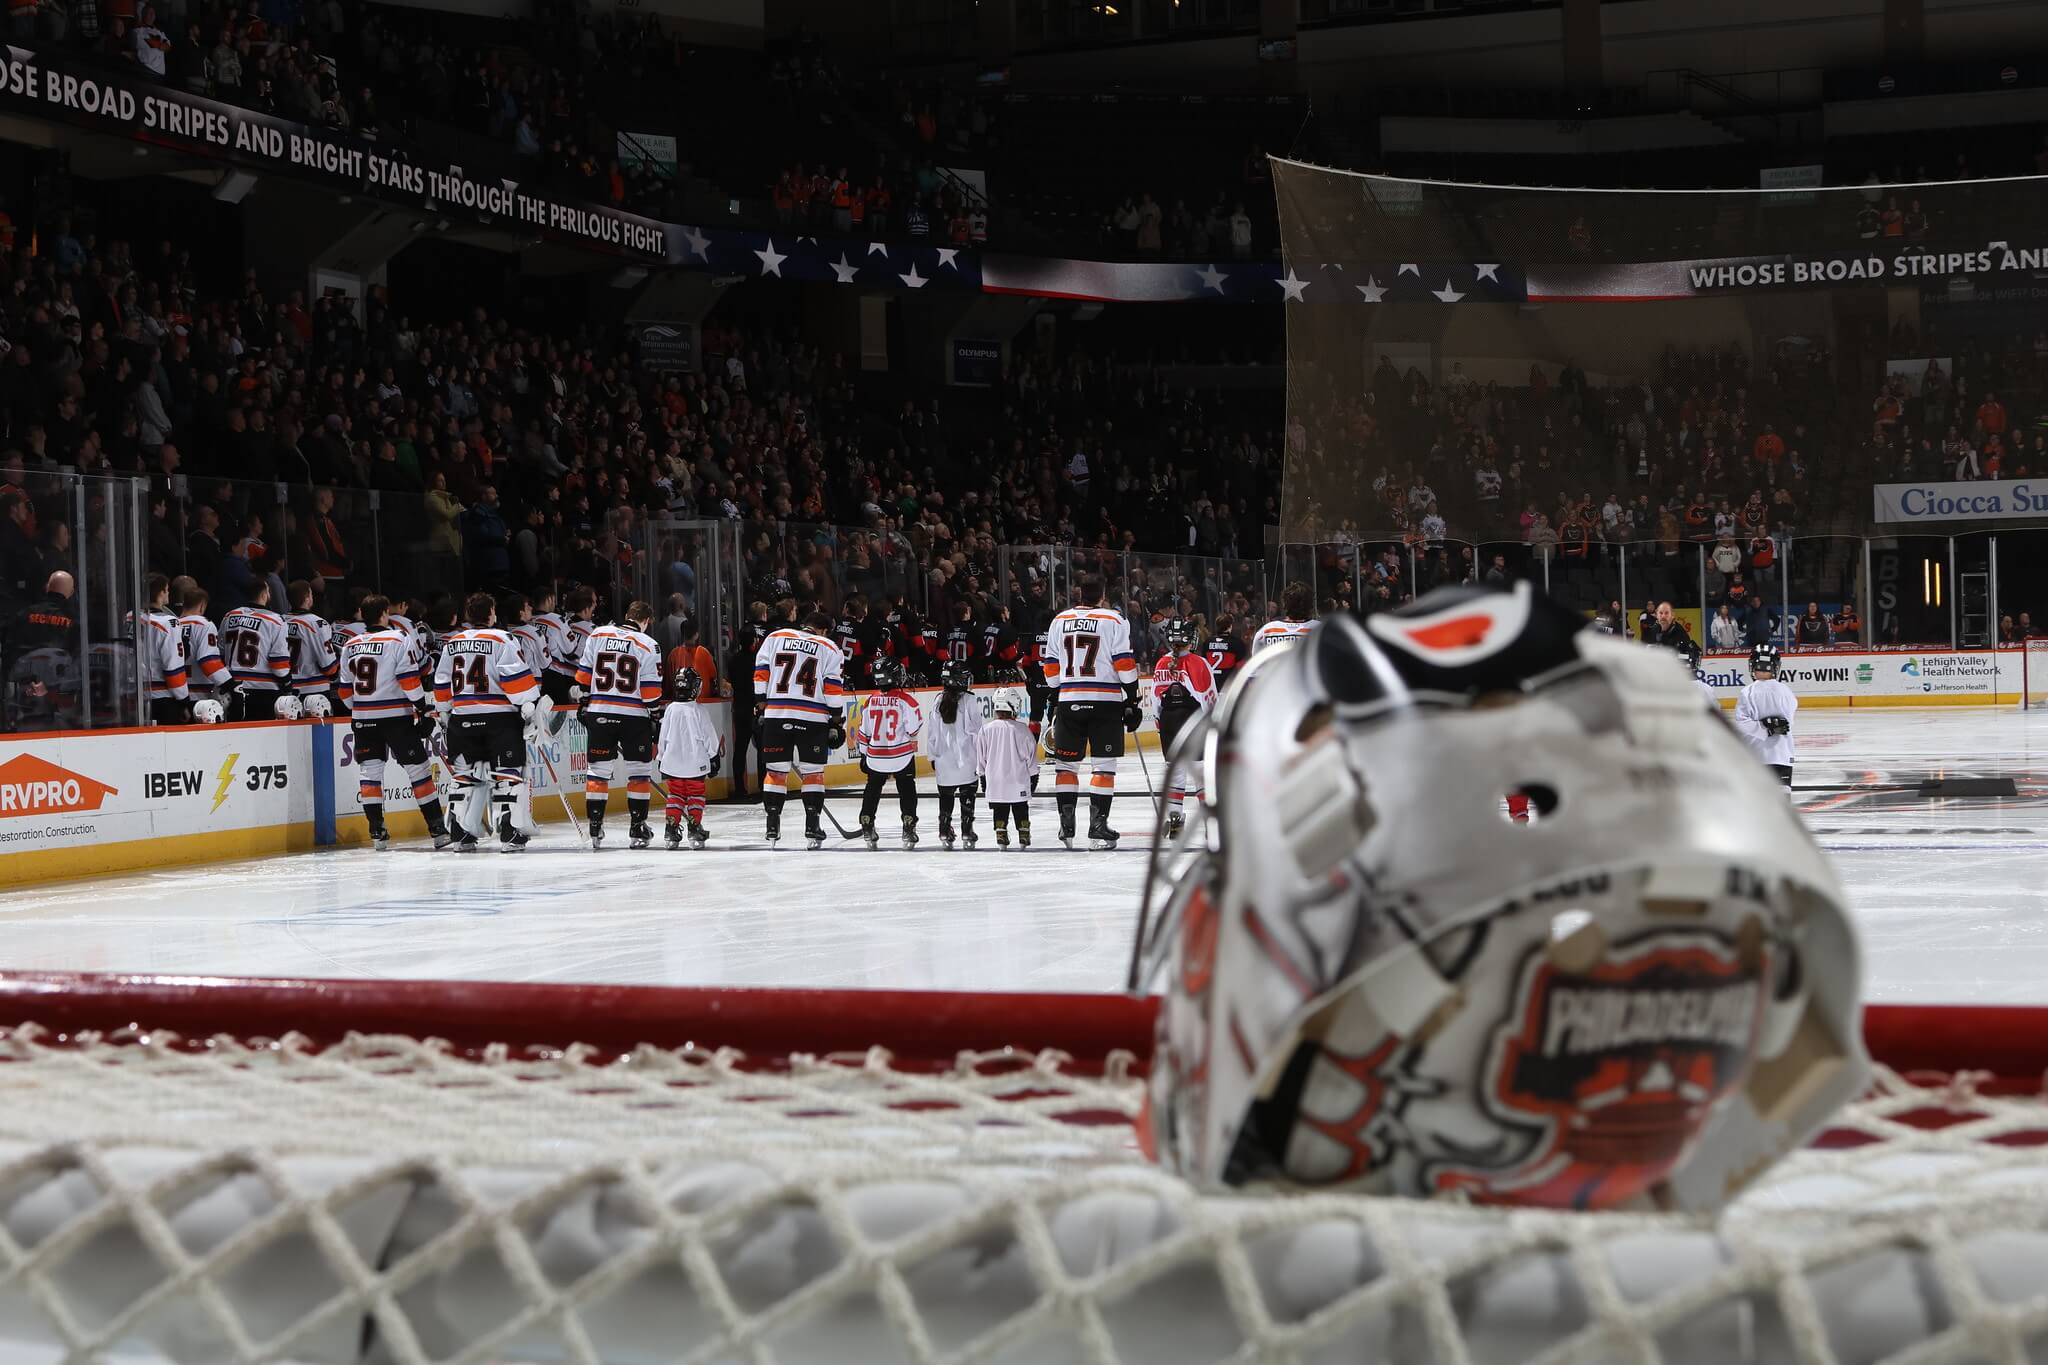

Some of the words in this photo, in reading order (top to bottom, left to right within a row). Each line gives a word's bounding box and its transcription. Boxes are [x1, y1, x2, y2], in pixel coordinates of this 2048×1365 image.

[47, 70, 136, 121] BROAD
[144, 96, 229, 145] STRIPES
[235, 121, 284, 158] AND
[290, 134, 362, 178] BRIGHT
[368, 155, 424, 194] STARS
[428, 171, 513, 217] THROUGH
[517, 195, 546, 224] THE
[550, 202, 620, 244] PERILOUS
[624, 223, 666, 256] FIGHT,
[1689, 261, 1785, 288] WHOSE
[1793, 257, 1885, 282] BROAD
[1893, 250, 1991, 277] STRIPES
[958, 348, 998, 358] OLYMPUS
[1901, 488, 2003, 515] Ciocca
[27, 612, 72, 628] SECURITY
[229, 616, 261, 630] SCHMIDT
[1064, 620, 1097, 632] WILSON
[225, 630, 261, 668] 76
[449, 640, 491, 654] BJARNASON
[607, 640, 629, 652] BONK
[784, 639, 818, 654] WISDOM
[1063, 634, 1100, 677] 17
[1212, 652, 1223, 675] 2
[1922, 657, 1955, 667] Lehigh
[1957, 656, 1988, 667] Valley
[452, 654, 489, 693] 64
[595, 652, 640, 694] 59
[775, 653, 818, 698] 74
[1779, 669, 1797, 682] AY
[1813, 668, 1849, 681] WIN!
[1922, 668, 1955, 677] Health
[1957, 666, 2002, 676] Network
[1933, 683, 1964, 692] Jefferson
[870, 709, 899, 741] 73
[145, 770, 203, 798] IBEW
[247, 765, 288, 791] 375
[45, 823, 96, 838] Construction.
